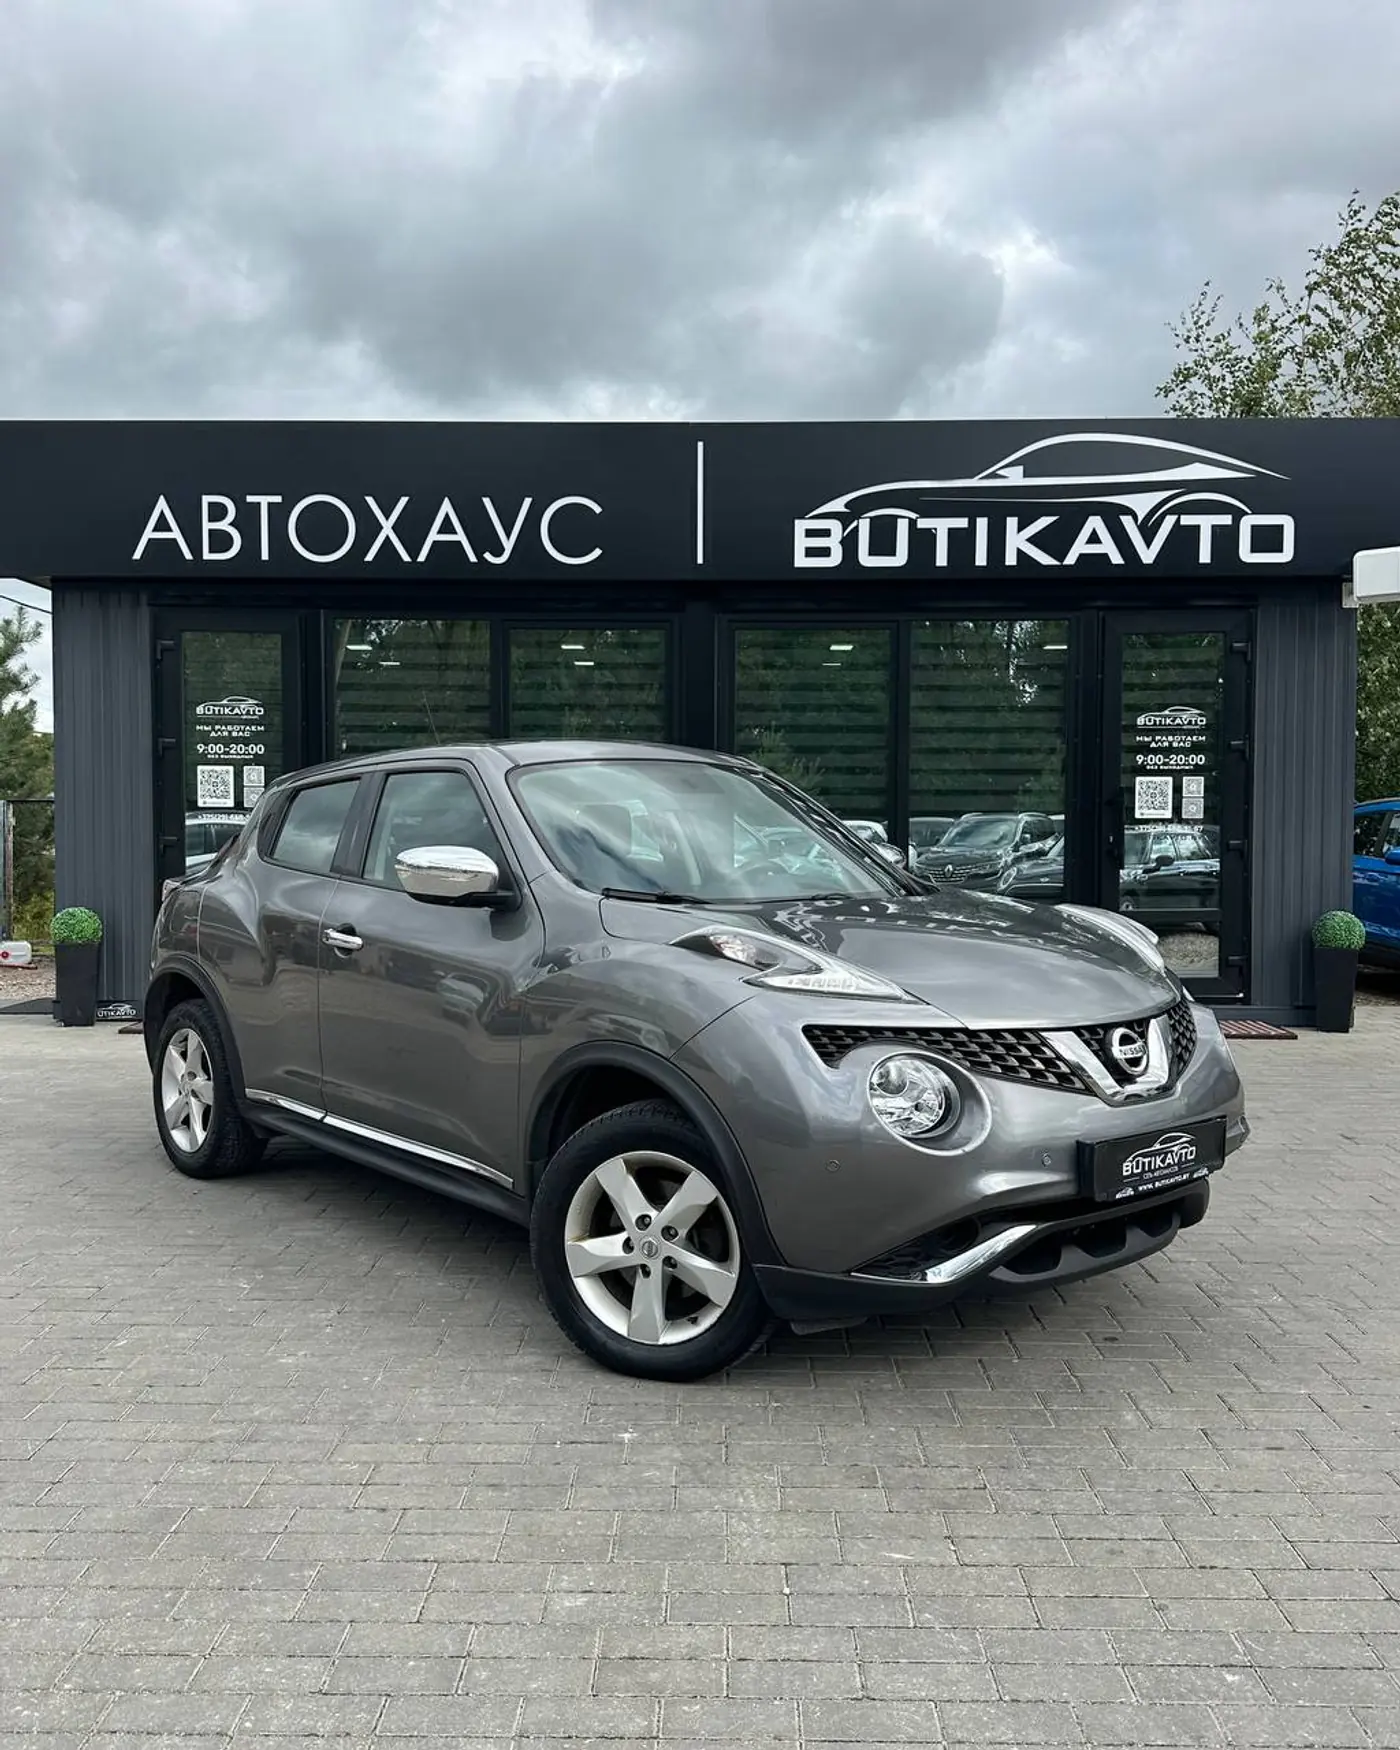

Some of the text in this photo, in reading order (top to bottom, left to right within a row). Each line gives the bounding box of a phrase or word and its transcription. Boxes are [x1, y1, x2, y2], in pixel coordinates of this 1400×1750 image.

[132, 493, 603, 565] АВТОХАУС
[794, 513, 1295, 567] BUTIKAVTO
[196, 706, 264, 715] BUTIKAVTO
[1137, 717, 1206, 726] BUTIKAVTO
[197, 743, 265, 755] 9:00-20:00
[1136, 754, 1205, 765] 9:00-20:00
[97, 1009, 137, 1017] UTIKAVTO
[1122, 1146, 1197, 1176] BUTIKAVTO
